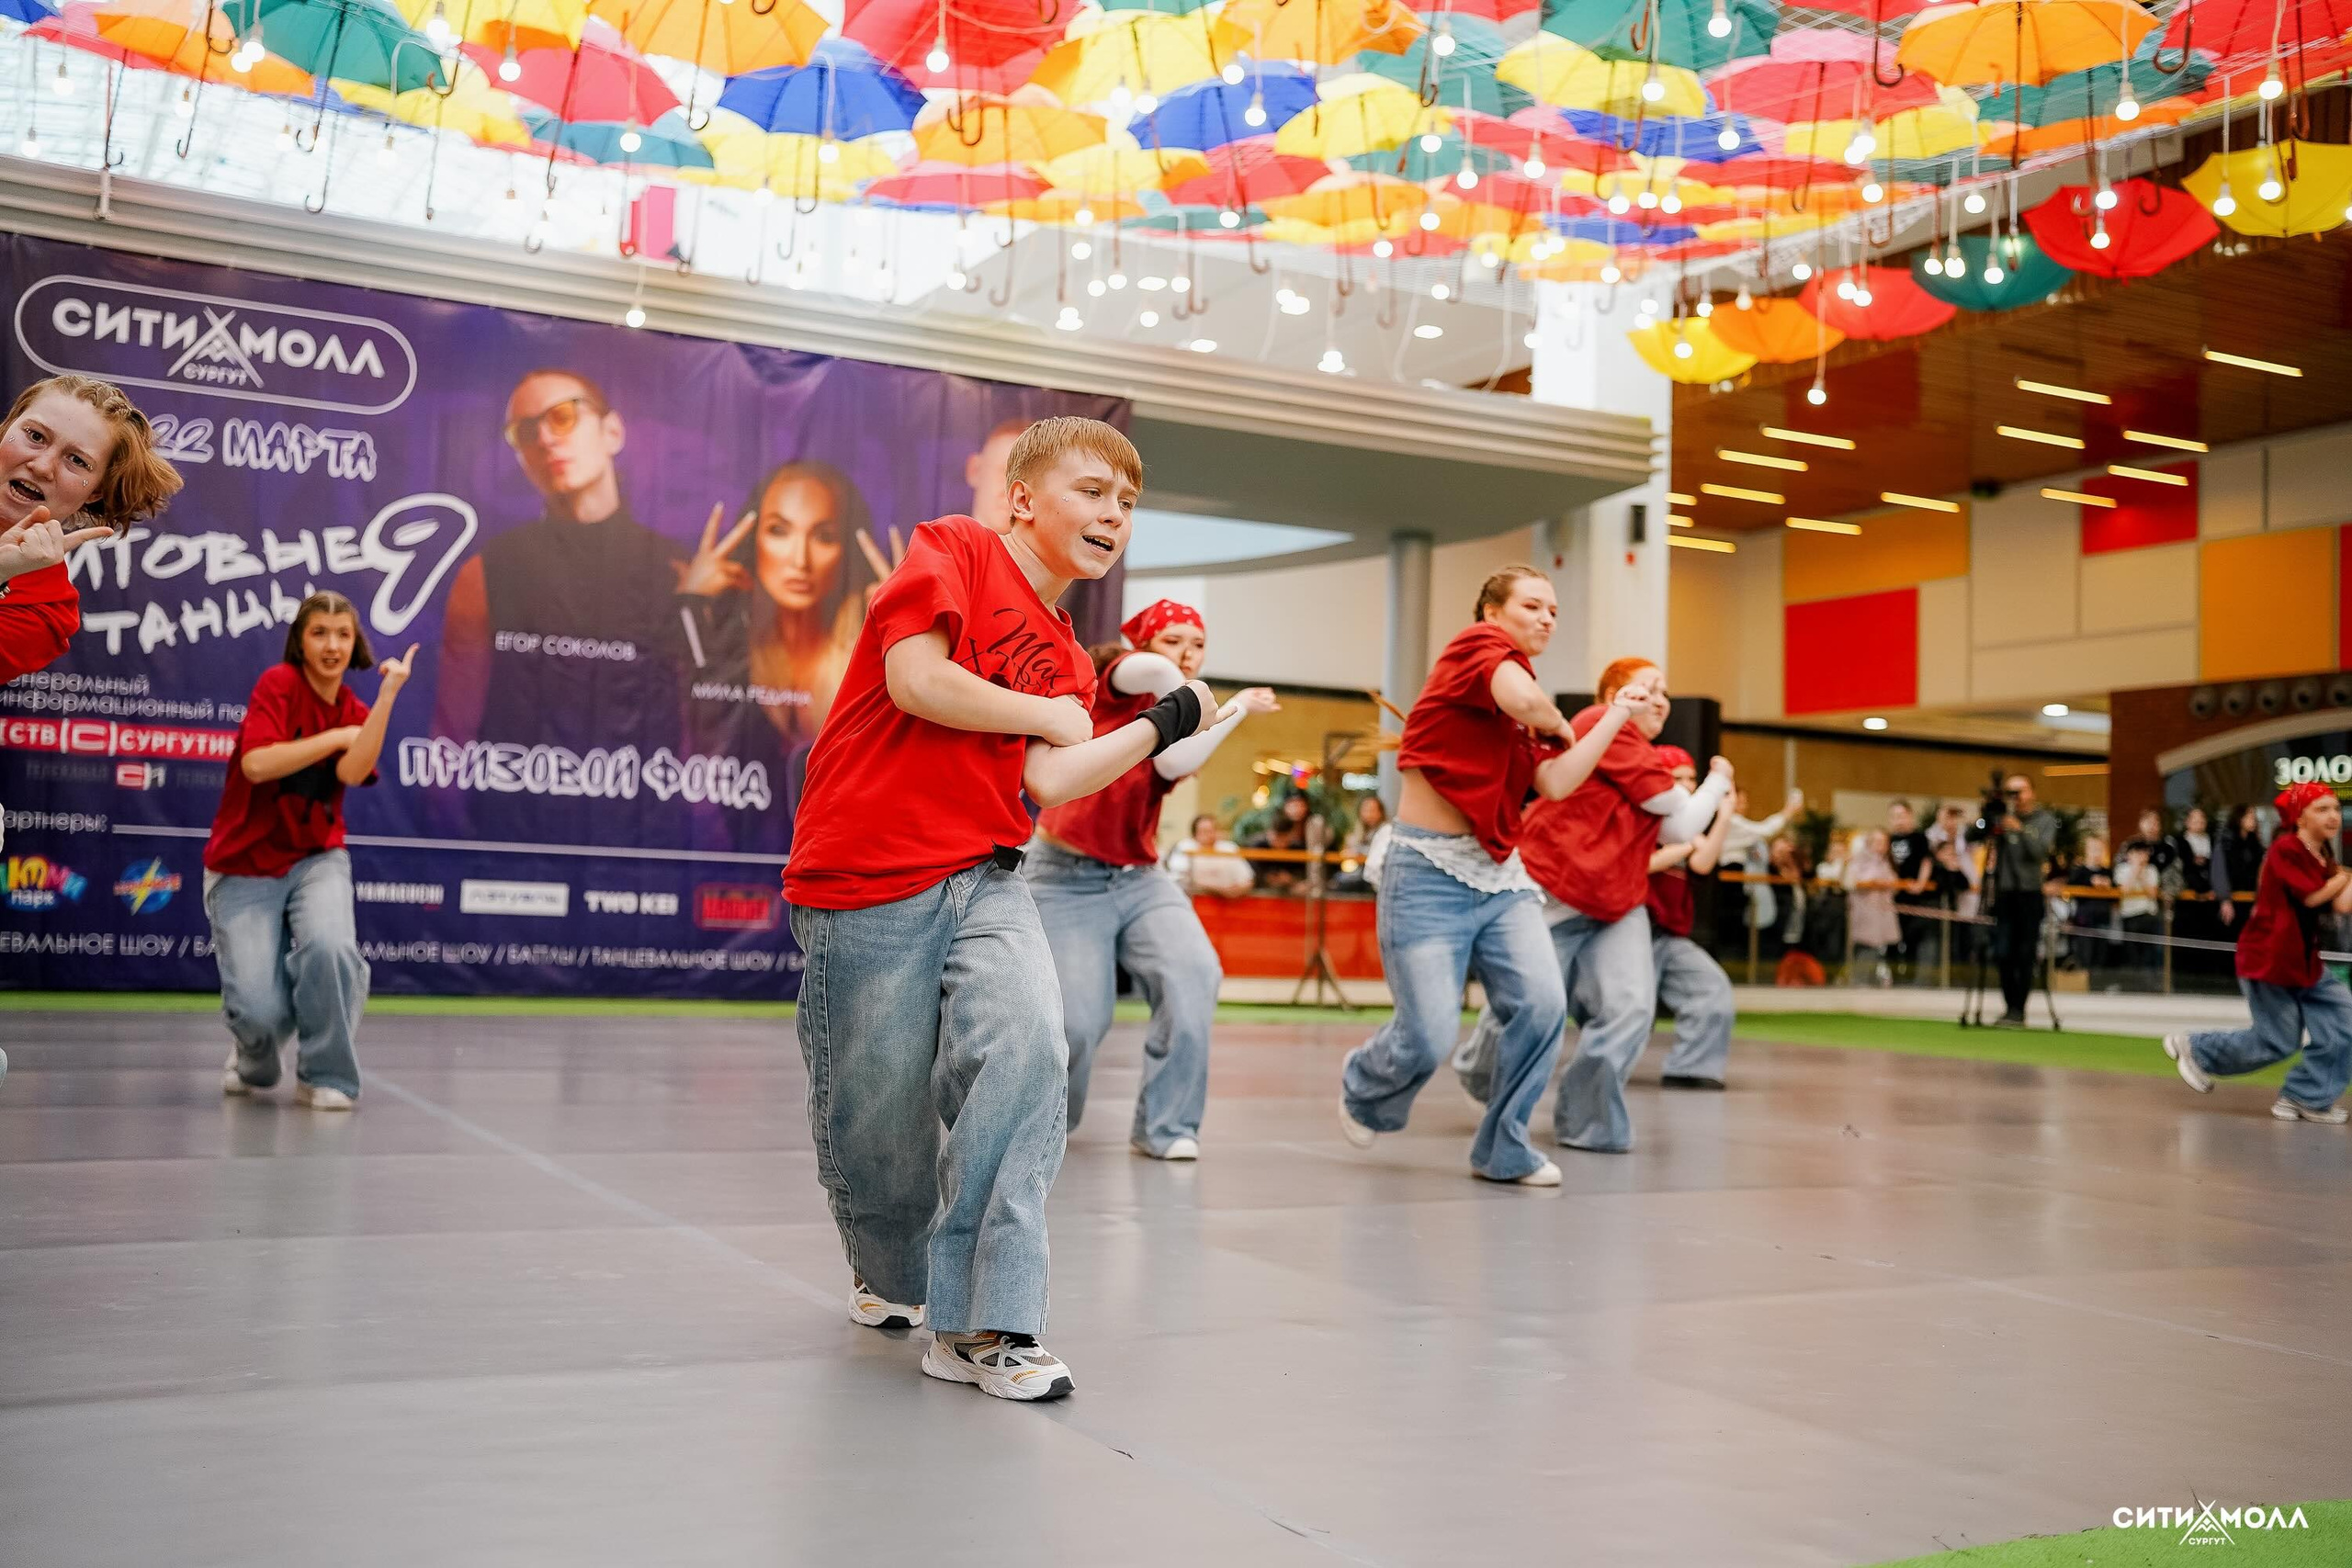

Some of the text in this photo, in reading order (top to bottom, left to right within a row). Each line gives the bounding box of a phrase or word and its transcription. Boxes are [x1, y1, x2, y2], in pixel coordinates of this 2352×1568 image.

[222, 417, 378, 482] МАРТА
[494, 630, 638, 661] ЕГОР СОКОЛОВ
[398, 736, 772, 811] ПРИЗОВОЙ ФОНД
[119, 933, 175, 956] ШОУ
[442, 942, 493, 964] ШОУ
[592, 946, 729, 971] ТАНЦЕВАЛЬНОЕ
[729, 949, 776, 971] ШОУ
